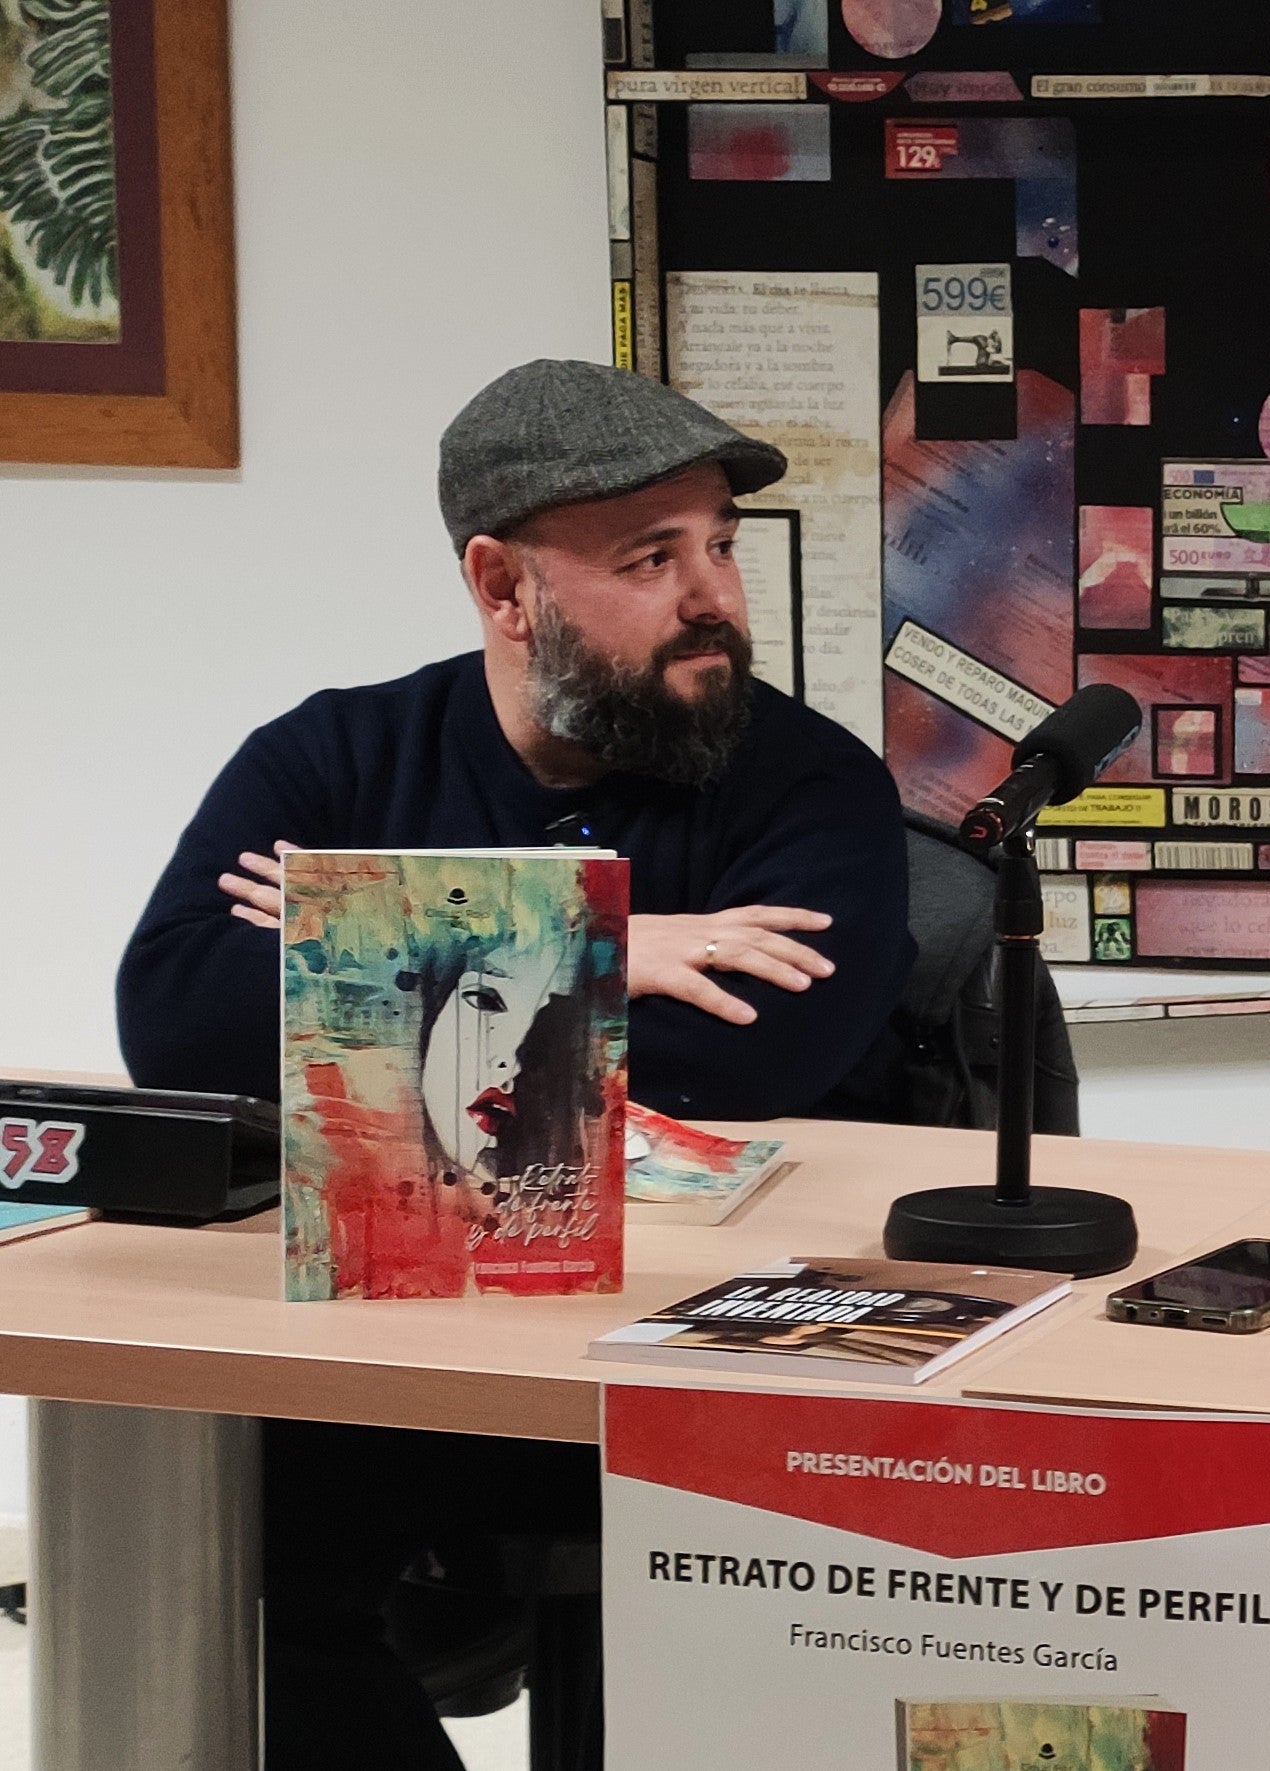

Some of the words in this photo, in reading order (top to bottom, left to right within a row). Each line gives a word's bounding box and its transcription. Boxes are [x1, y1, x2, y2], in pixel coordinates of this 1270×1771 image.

[663, 76, 724, 98] virgen
[922, 276, 1005, 311] 599€
[1169, 550, 1200, 565] 500
[936, 671, 956, 691] DE
[957, 682, 998, 716] TODAS
[955, 657, 1006, 694] REPARO
[687, 1299, 875, 1324] INVENTADA
[722, 1285, 769, 1300] LA
[766, 1286, 906, 1308] REALIDAD
[786, 1450, 972, 1485] PRESENTACIÓN
[979, 1463, 1026, 1491] DEL
[1032, 1467, 1107, 1497] LIBRO
[649, 1551, 816, 1593] RETRATO
[826, 1564, 876, 1598] DE
[887, 1570, 1030, 1610] FRENTE
[1038, 1581, 1063, 1612] Y
[1076, 1584, 1127, 1618] DE
[790, 1624, 913, 1658] Francisco
[920, 1634, 1025, 1666] Fuentes
[1033, 1643, 1119, 1673] García
